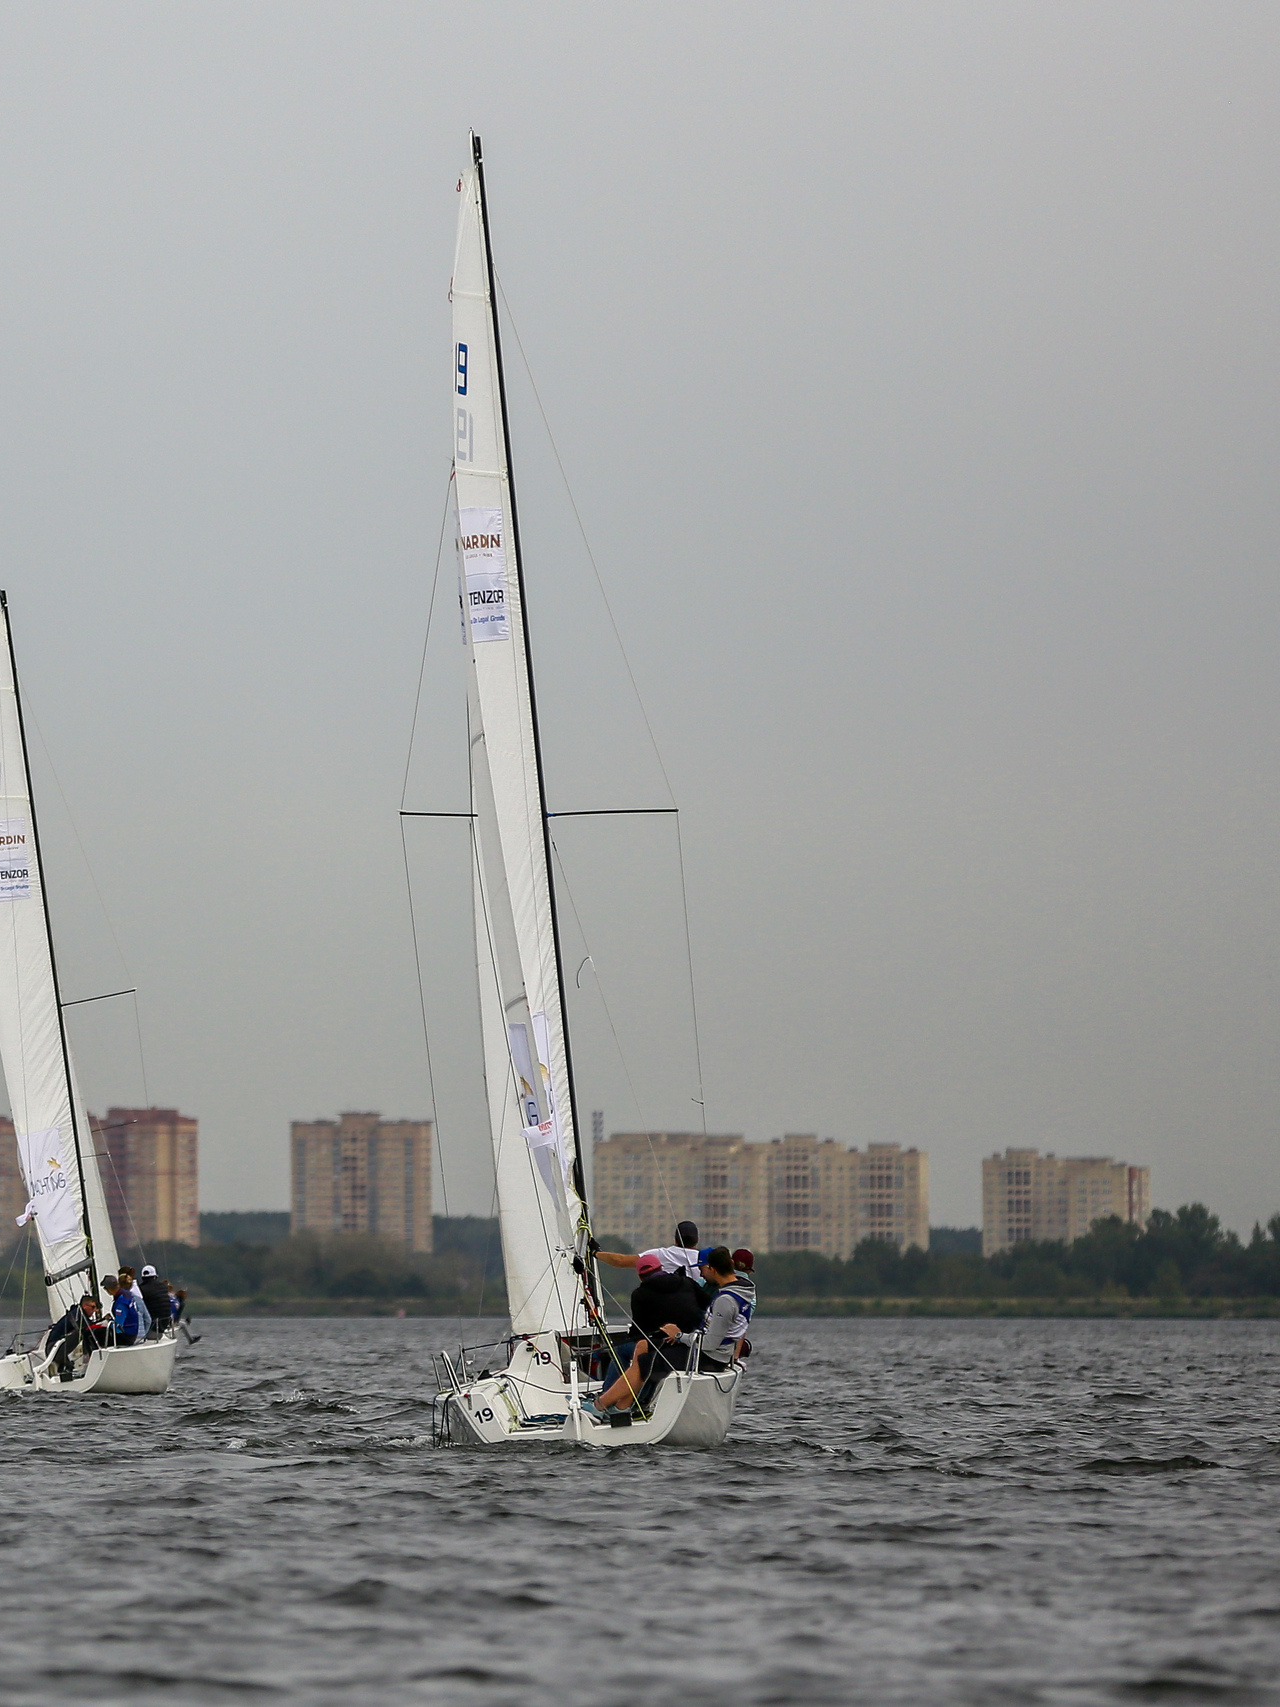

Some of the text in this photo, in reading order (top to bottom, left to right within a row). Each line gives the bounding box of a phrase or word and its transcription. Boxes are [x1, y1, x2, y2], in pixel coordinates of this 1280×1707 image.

[469, 589, 504, 606] TENZOR
[532, 1351, 552, 1366] 19
[474, 1407, 494, 1424] 19
